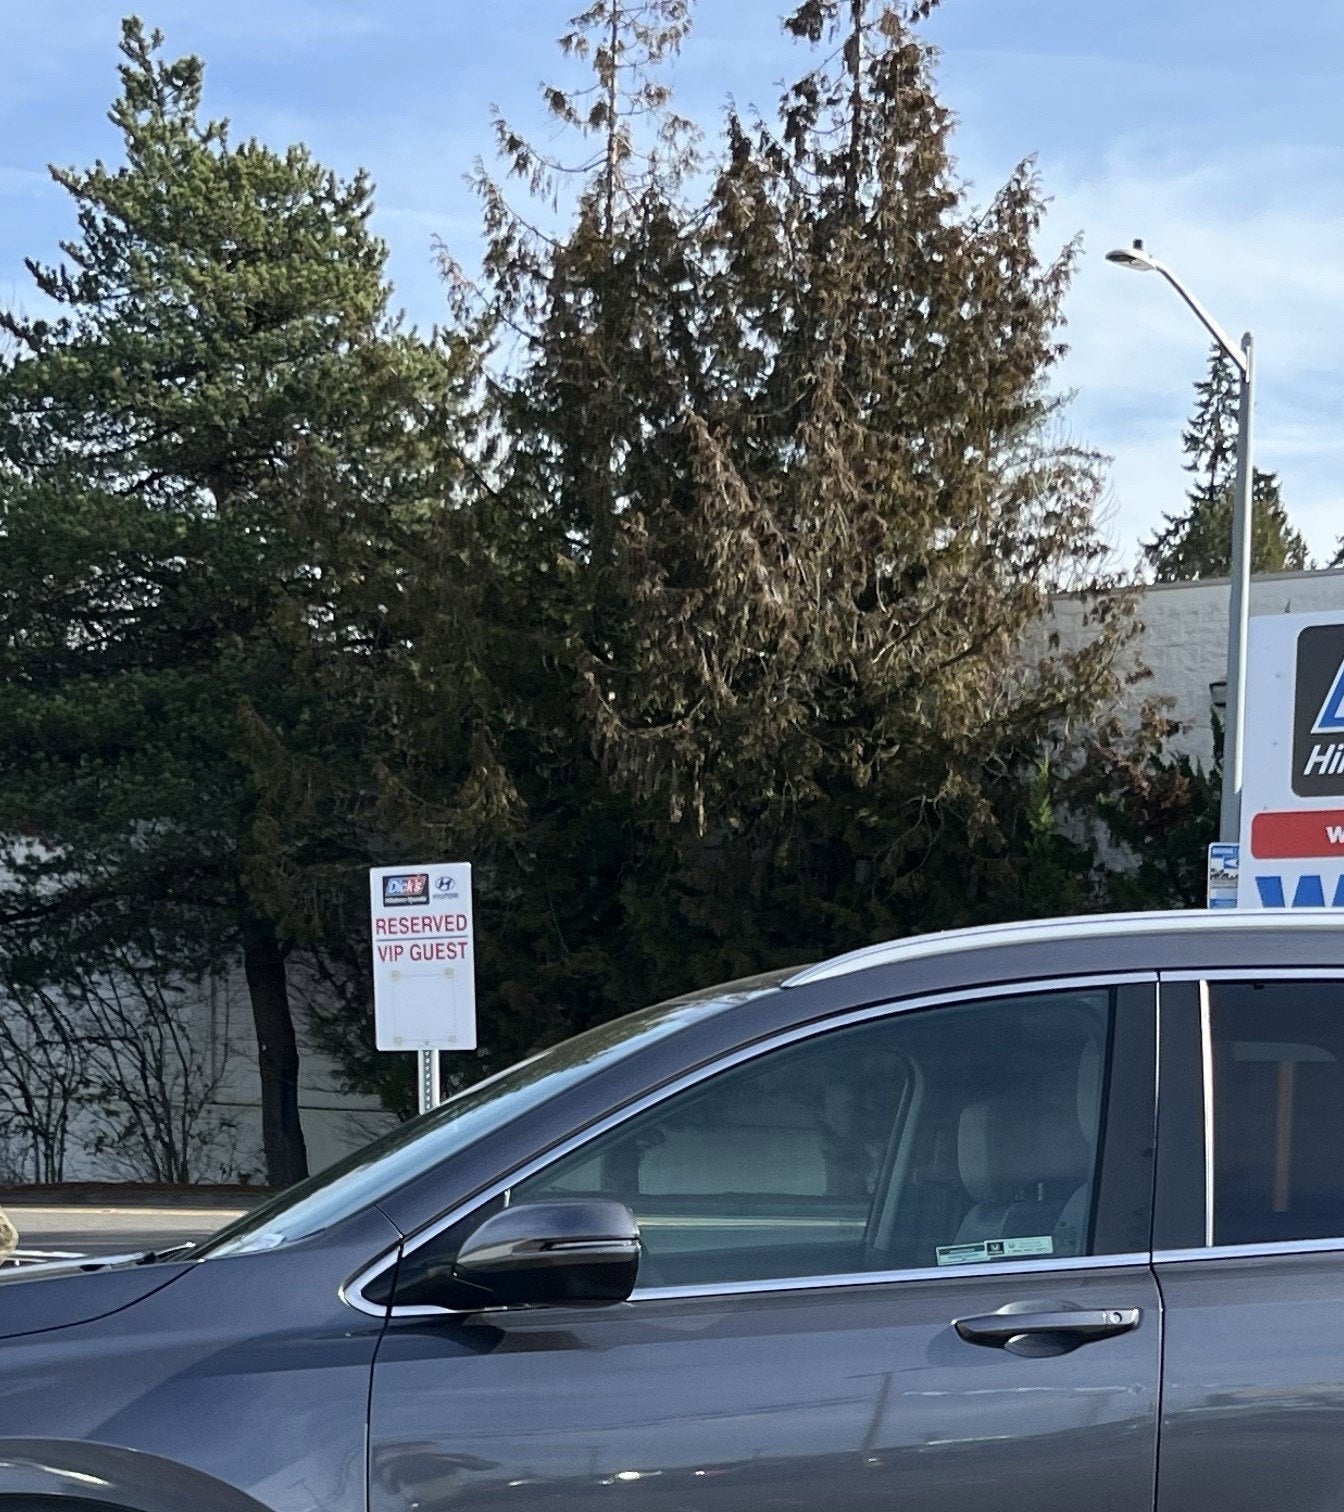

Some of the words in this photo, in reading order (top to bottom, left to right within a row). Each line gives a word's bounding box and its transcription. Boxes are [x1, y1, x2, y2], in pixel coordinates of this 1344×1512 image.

[375, 914, 468, 935] RESERVED
[377, 944, 404, 962] VIP
[410, 942, 468, 961] GUEST
